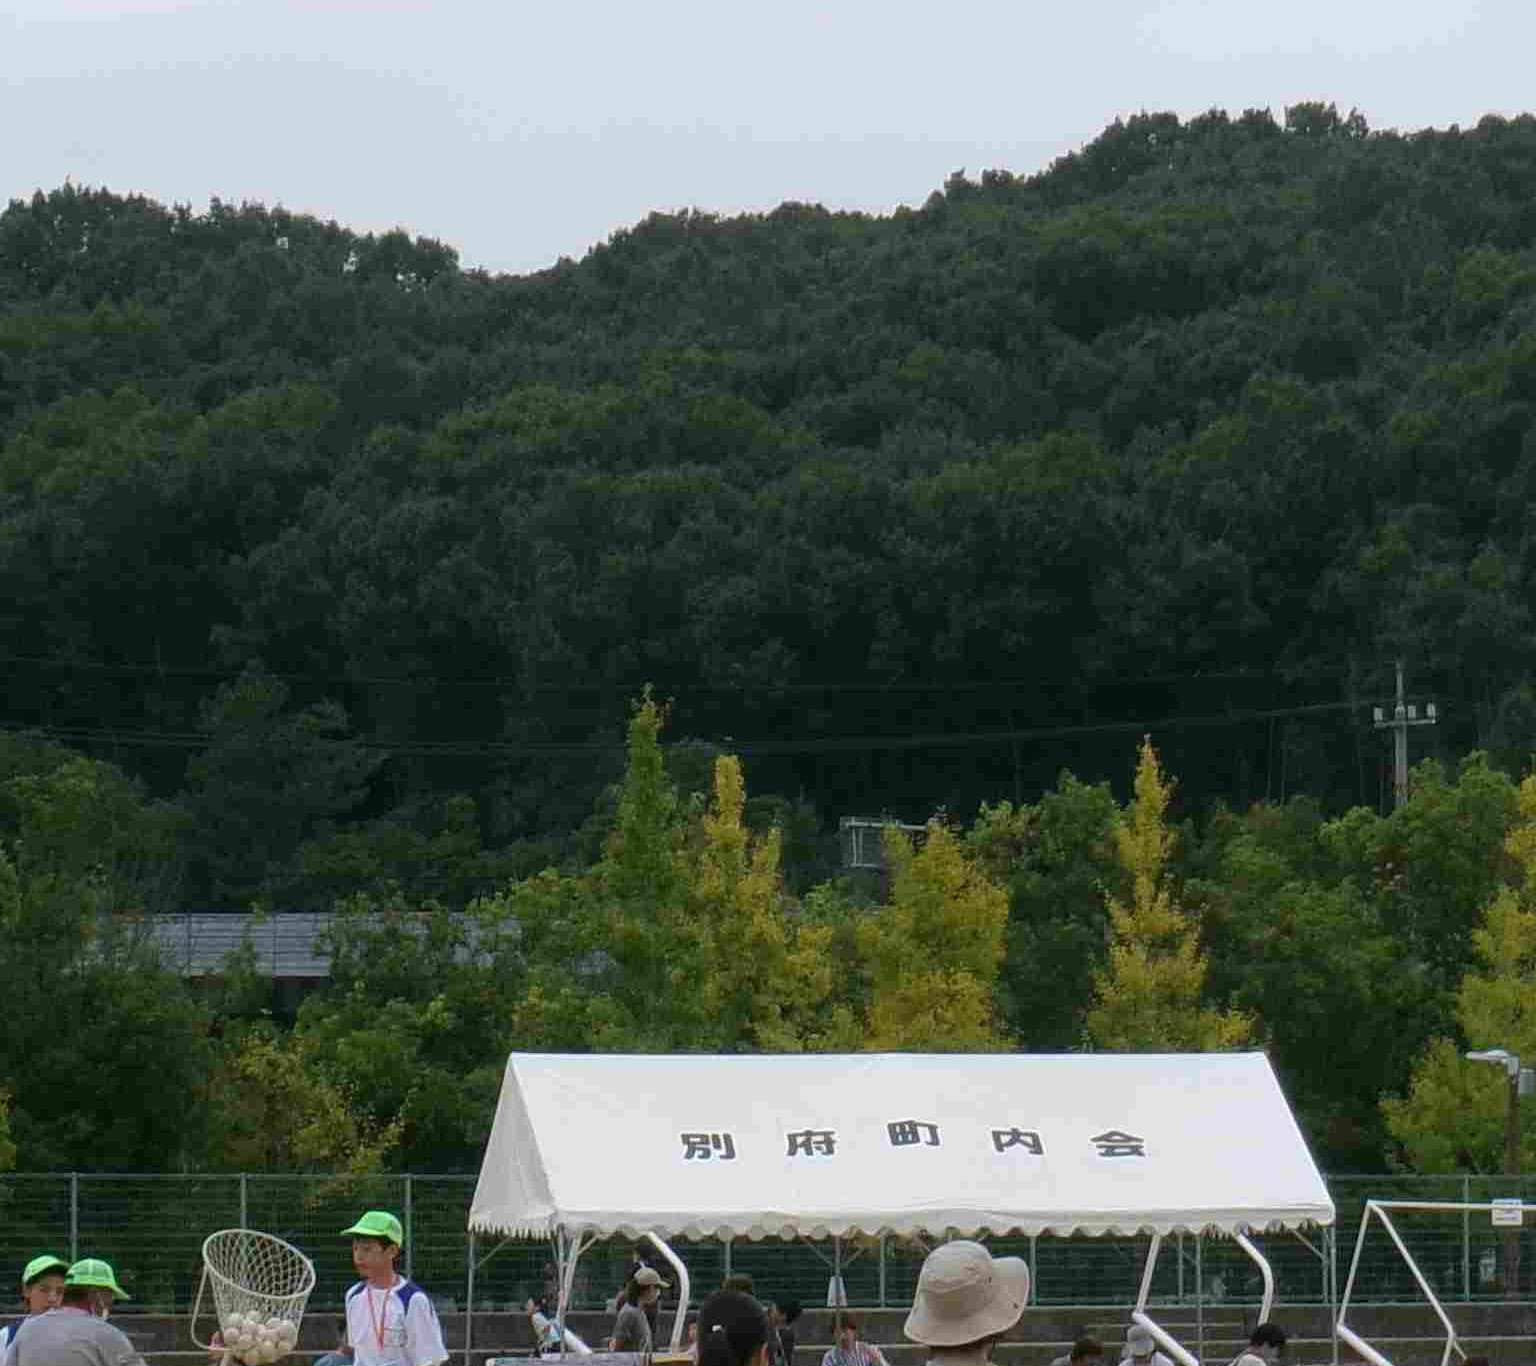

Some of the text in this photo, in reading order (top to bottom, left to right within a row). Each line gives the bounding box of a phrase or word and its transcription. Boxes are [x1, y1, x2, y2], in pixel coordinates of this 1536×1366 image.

[680, 1119, 1146, 1160] 別府町内会
